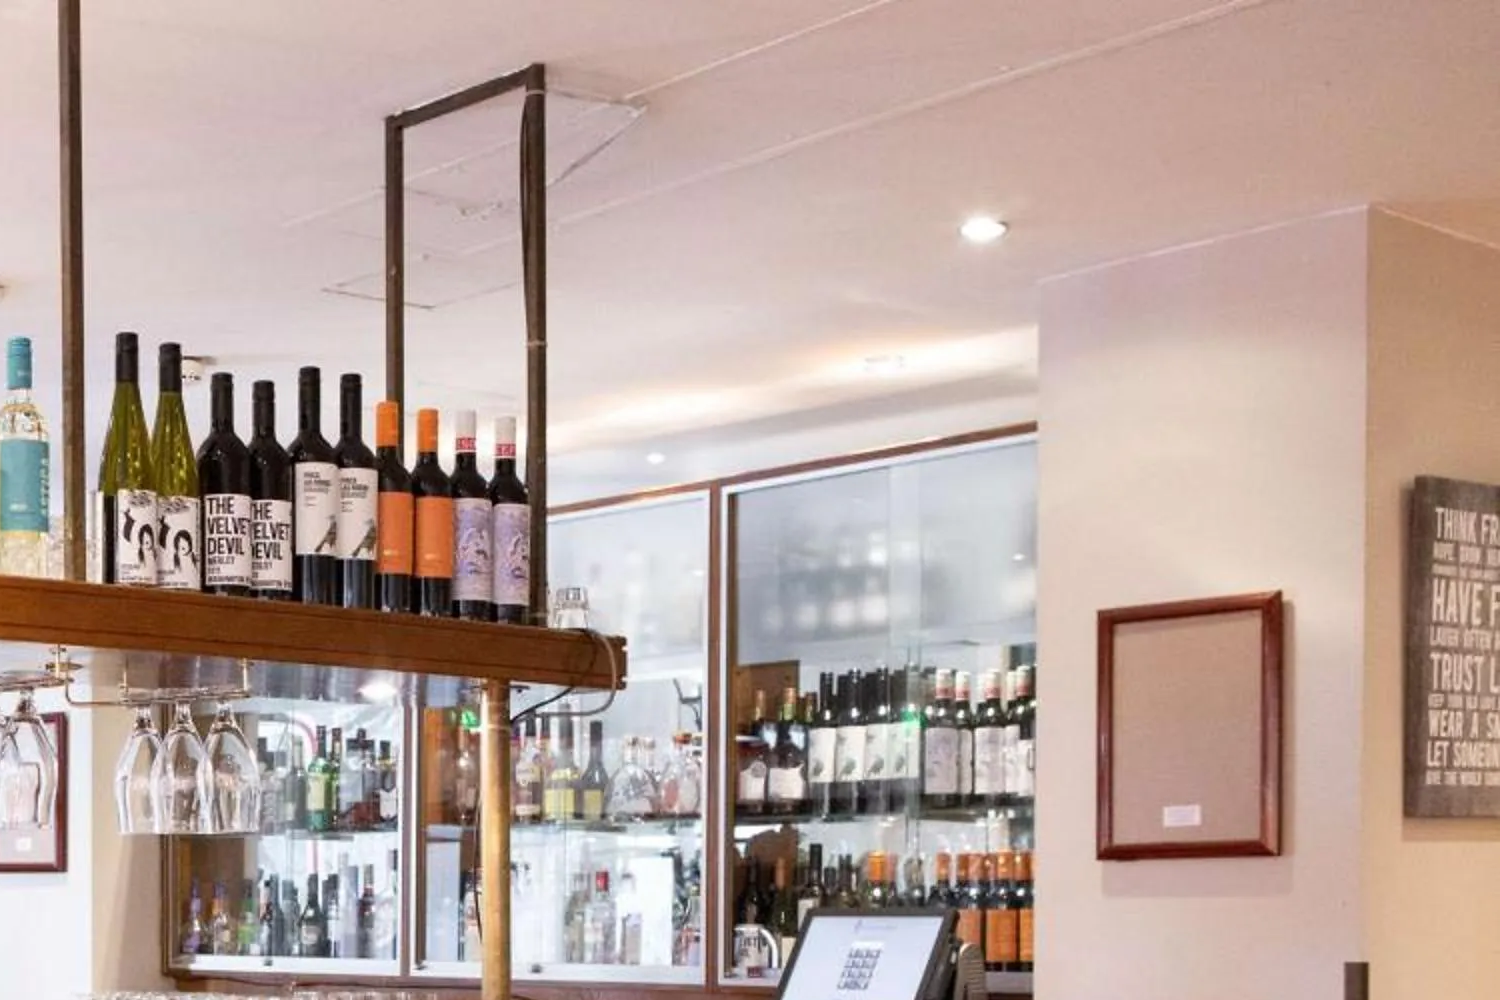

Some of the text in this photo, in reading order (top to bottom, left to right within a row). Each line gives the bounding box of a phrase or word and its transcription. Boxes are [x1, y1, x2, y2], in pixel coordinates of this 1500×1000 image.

[207, 496, 235, 515] THE
[251, 522, 290, 541] ELVET
[1435, 507, 1500, 545] THINK FR
[207, 537, 245, 555] DEVIL
[1432, 577, 1484, 625] HAVE
[1430, 652, 1485, 693] TRUST
[1428, 710, 1464, 738] WEAR
[1469, 711, 1479, 739] A
[1427, 740, 1451, 768] LET
